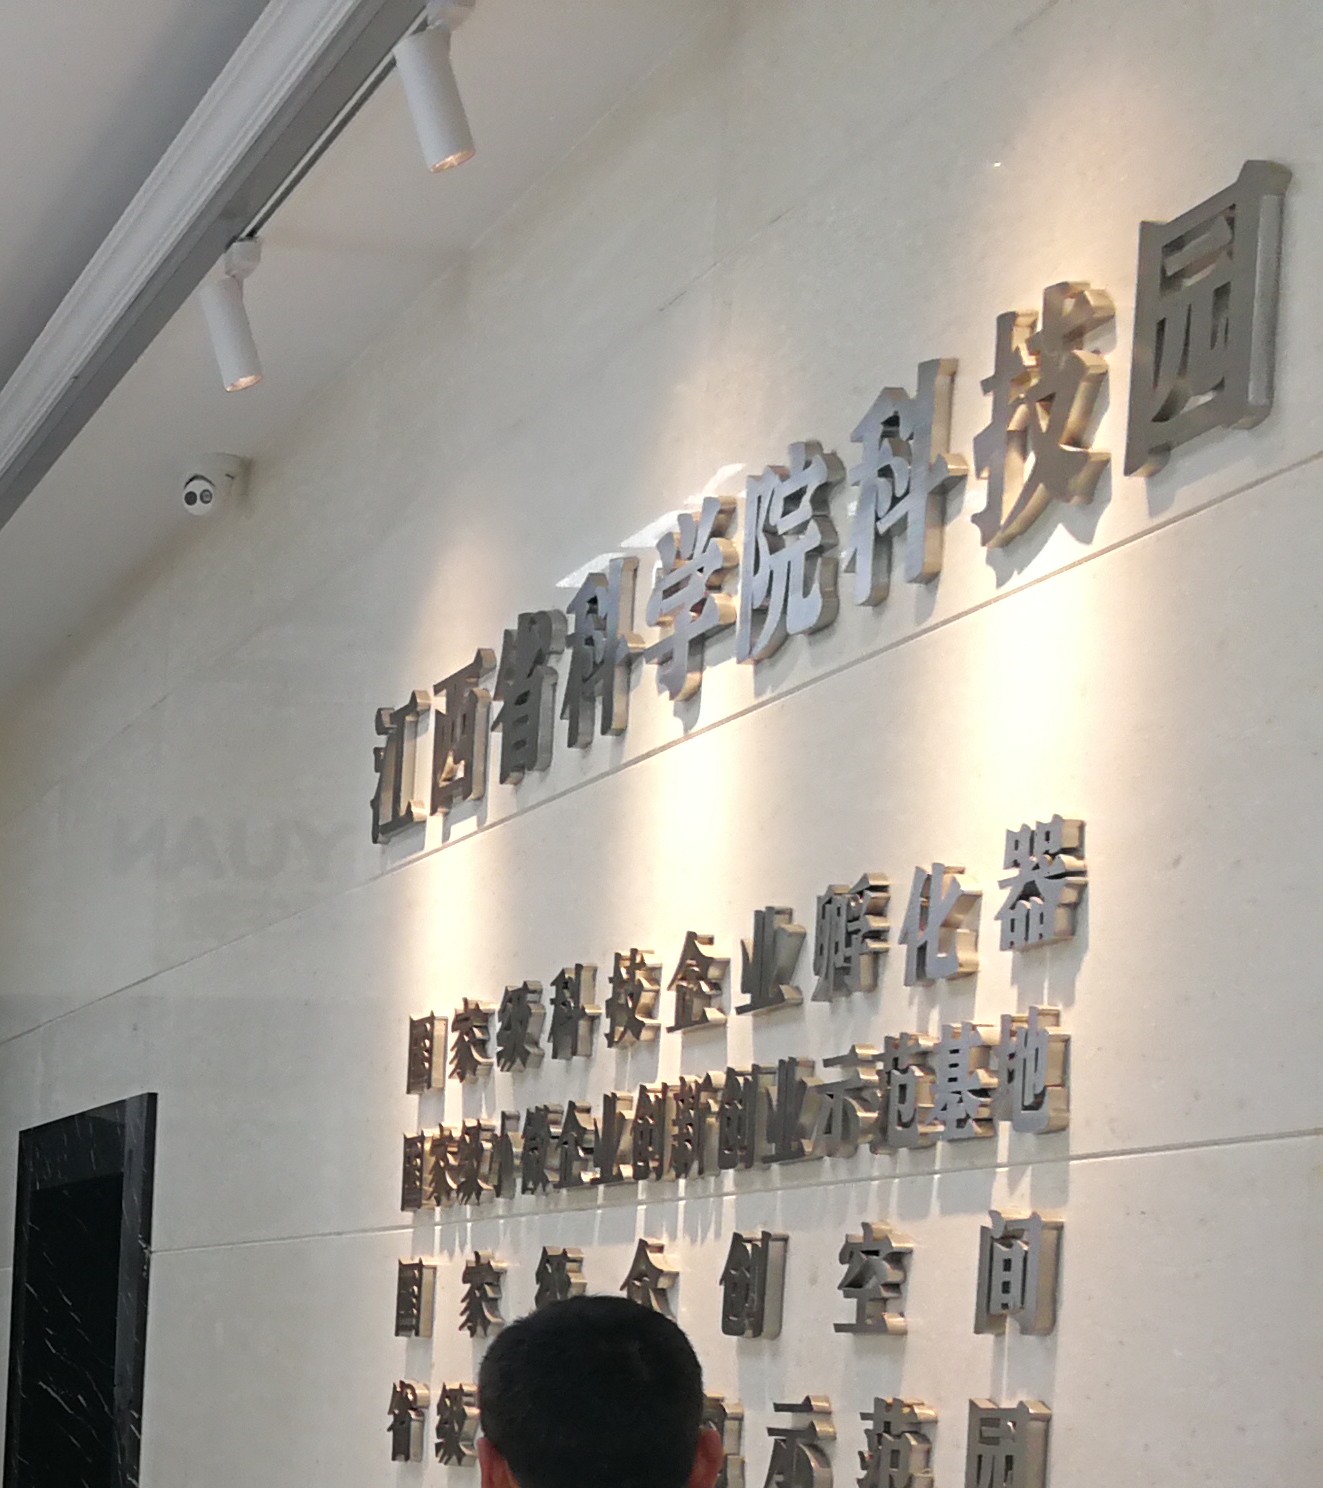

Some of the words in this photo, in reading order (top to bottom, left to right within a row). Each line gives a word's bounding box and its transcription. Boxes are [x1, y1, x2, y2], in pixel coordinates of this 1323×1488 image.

[371, 158, 1293, 845] 江西省科学院科技园
